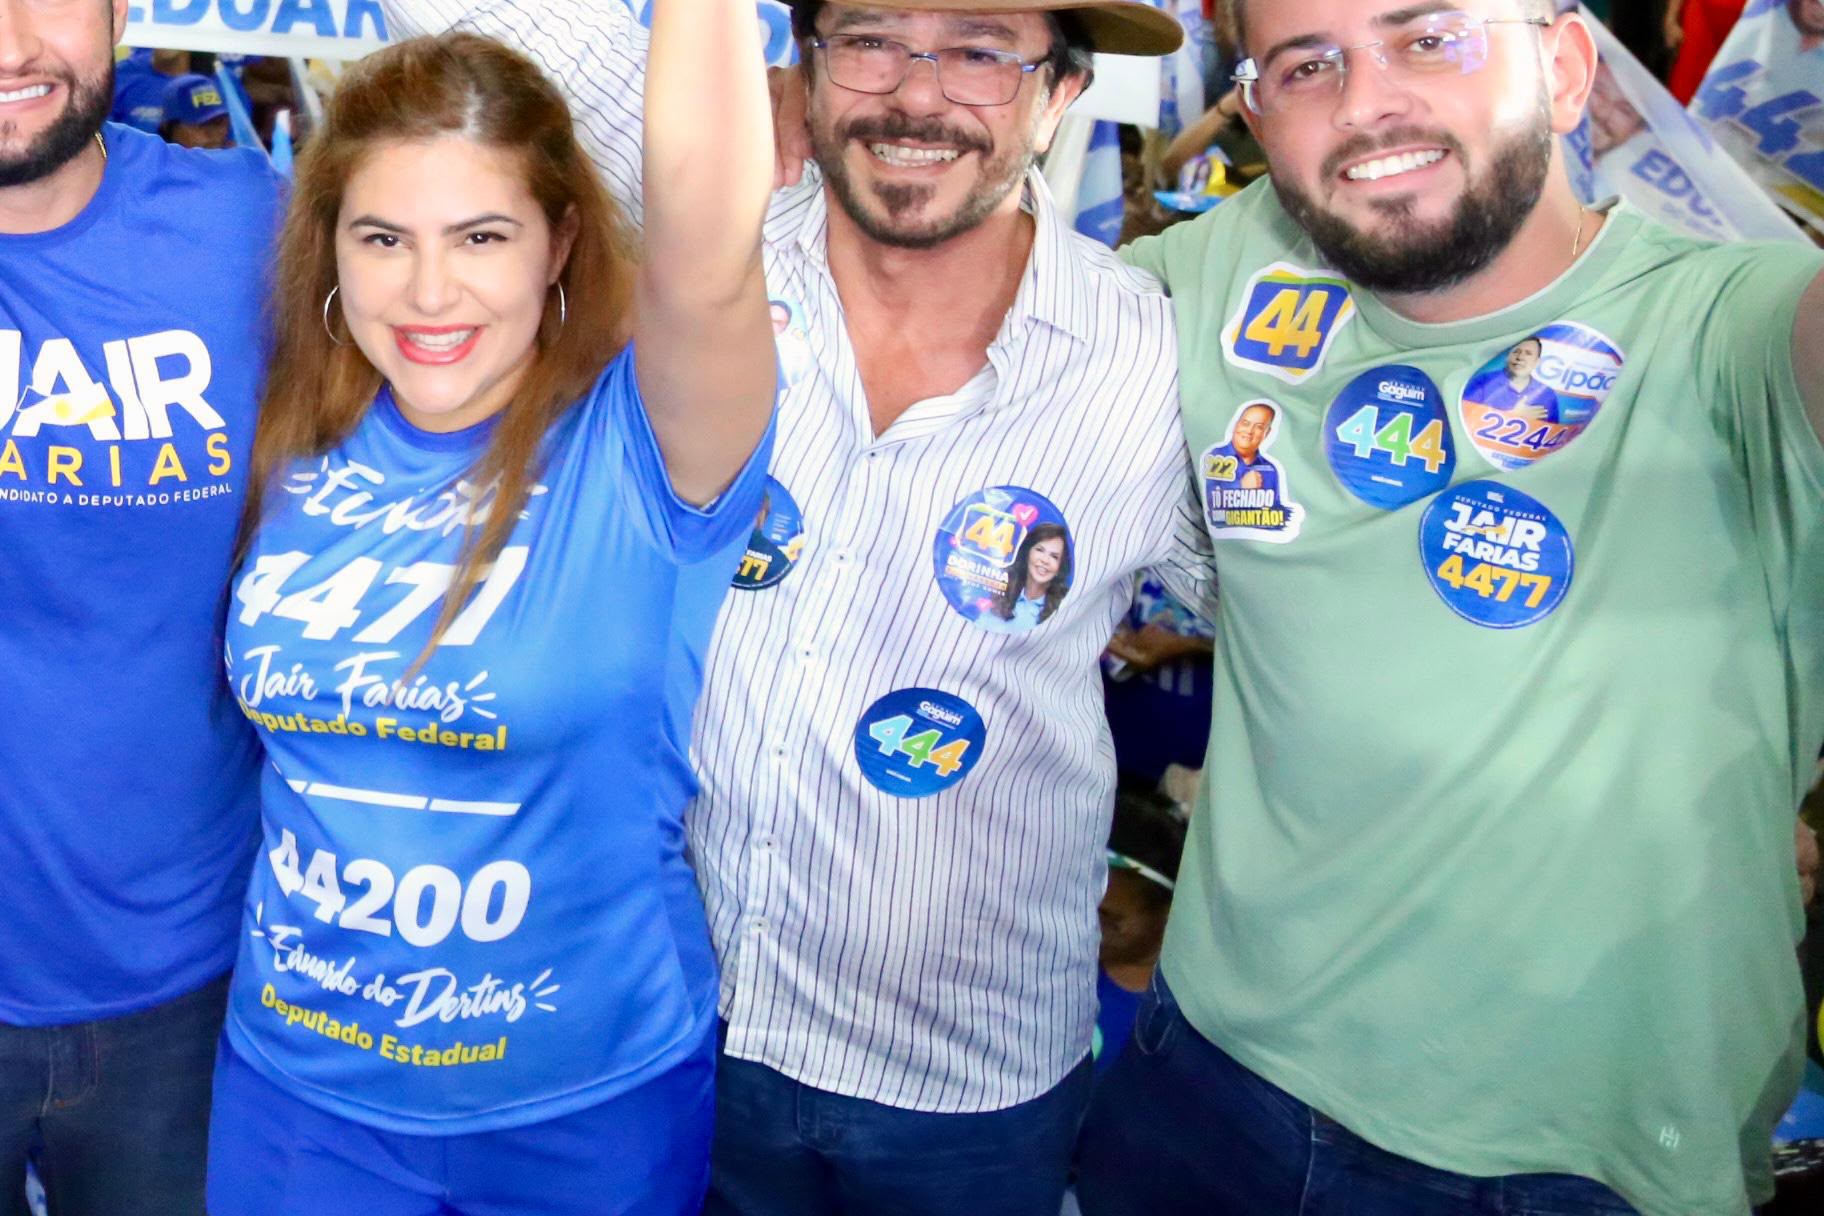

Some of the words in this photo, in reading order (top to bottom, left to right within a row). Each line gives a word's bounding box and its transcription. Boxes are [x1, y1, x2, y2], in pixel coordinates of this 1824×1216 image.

[1245, 289, 1329, 358] 44
[1336, 405, 1446, 474] 444
[63, 493, 73, 505] A
[78, 493, 169, 507] DEPUTADO
[174, 483, 232, 504] FEDERAL
[1223, 489, 1275, 508] FECHADO
[965, 516, 1015, 559] 44
[1442, 532, 1540, 572] FARIAS
[1443, 501, 1547, 551] JAIR
[1437, 554, 1552, 608] 4477
[241, 645, 318, 707] Jair
[334, 651, 467, 722] Farias
[377, 717, 508, 751] Federal
[869, 714, 970, 777] 444
[269, 828, 531, 947] 44200
[268, 925, 361, 995] Eduardo
[363, 974, 404, 1006] do
[393, 967, 527, 1028] Dertins
[261, 982, 373, 1050] Deputado
[380, 1034, 507, 1067] Estadual
